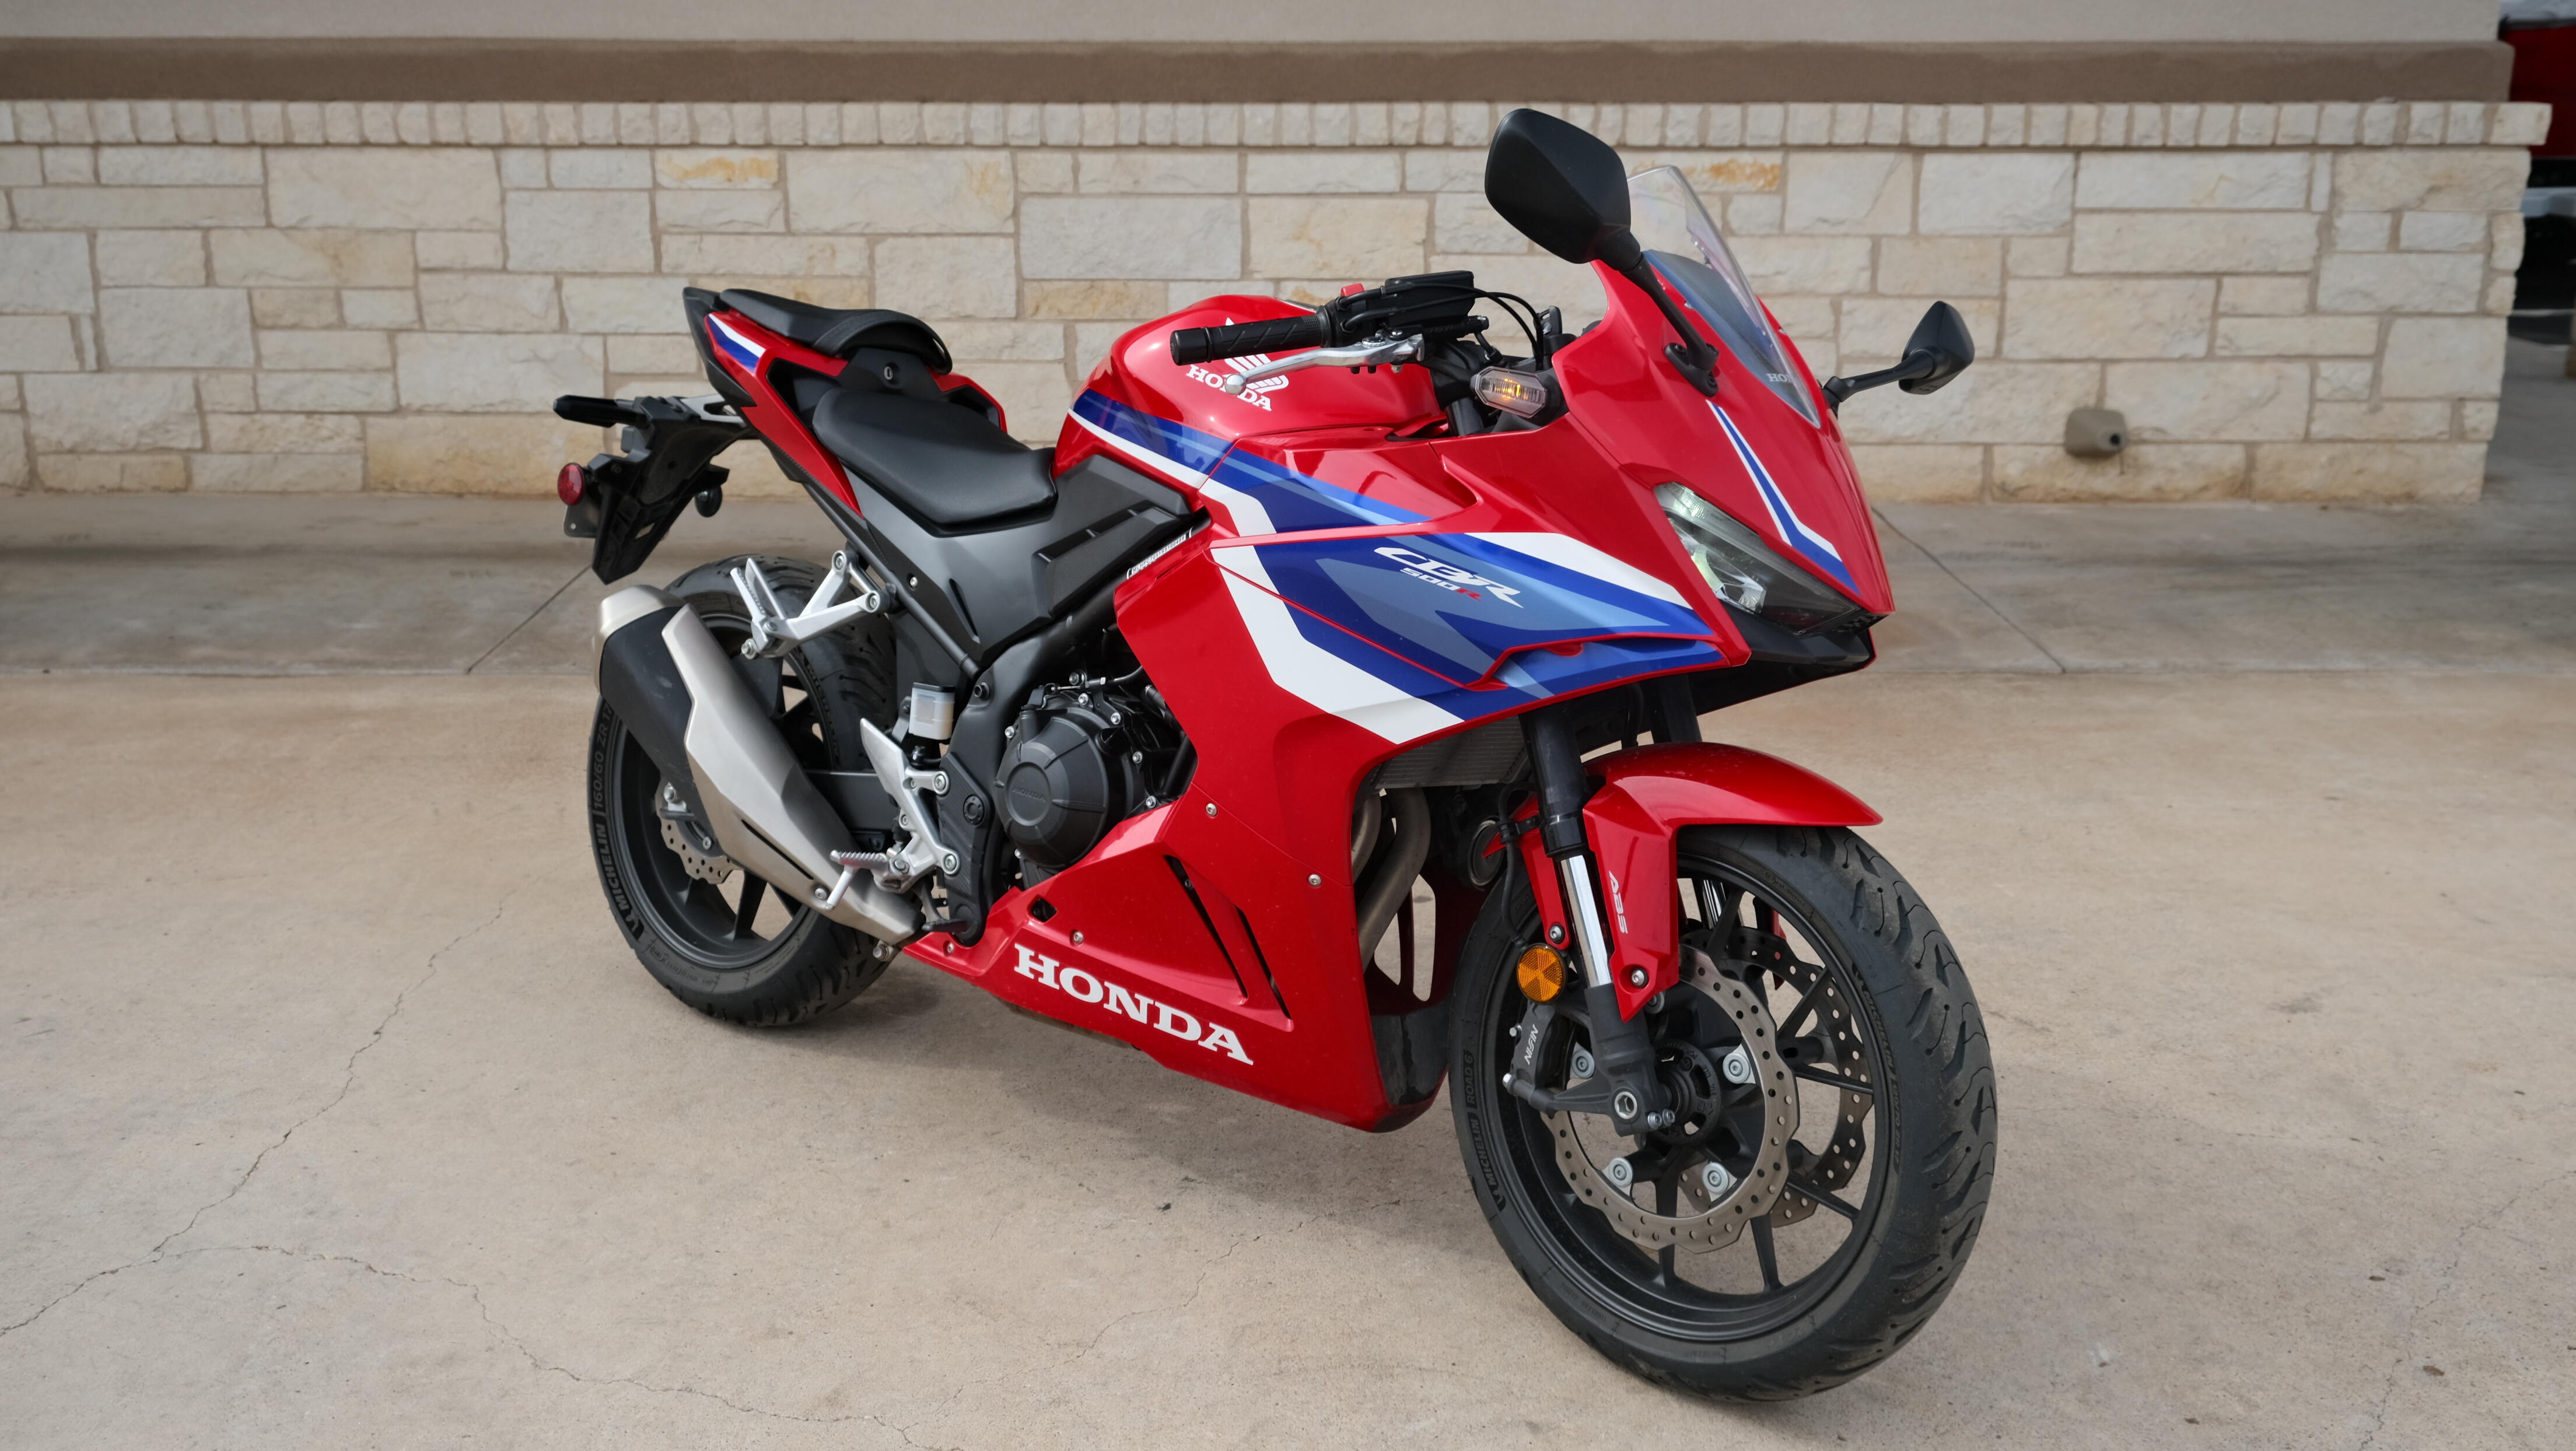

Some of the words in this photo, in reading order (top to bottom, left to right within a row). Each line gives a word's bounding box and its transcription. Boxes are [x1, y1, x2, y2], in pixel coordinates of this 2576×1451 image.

[1186, 364, 1272, 412] HODA
[1374, 546, 1525, 609] CBR
[597, 723, 608, 748] ZR
[601, 702, 612, 720] 17
[593, 751, 604, 809] 160/60
[595, 822, 631, 911] MICHELIN
[1608, 870, 1629, 934] ABS
[1014, 942, 1254, 1066] HONDA
[1464, 1053, 1474, 1064] 6
[1464, 1067, 1476, 1105] ROAD
[1469, 1117, 1498, 1187] MICHELIN
